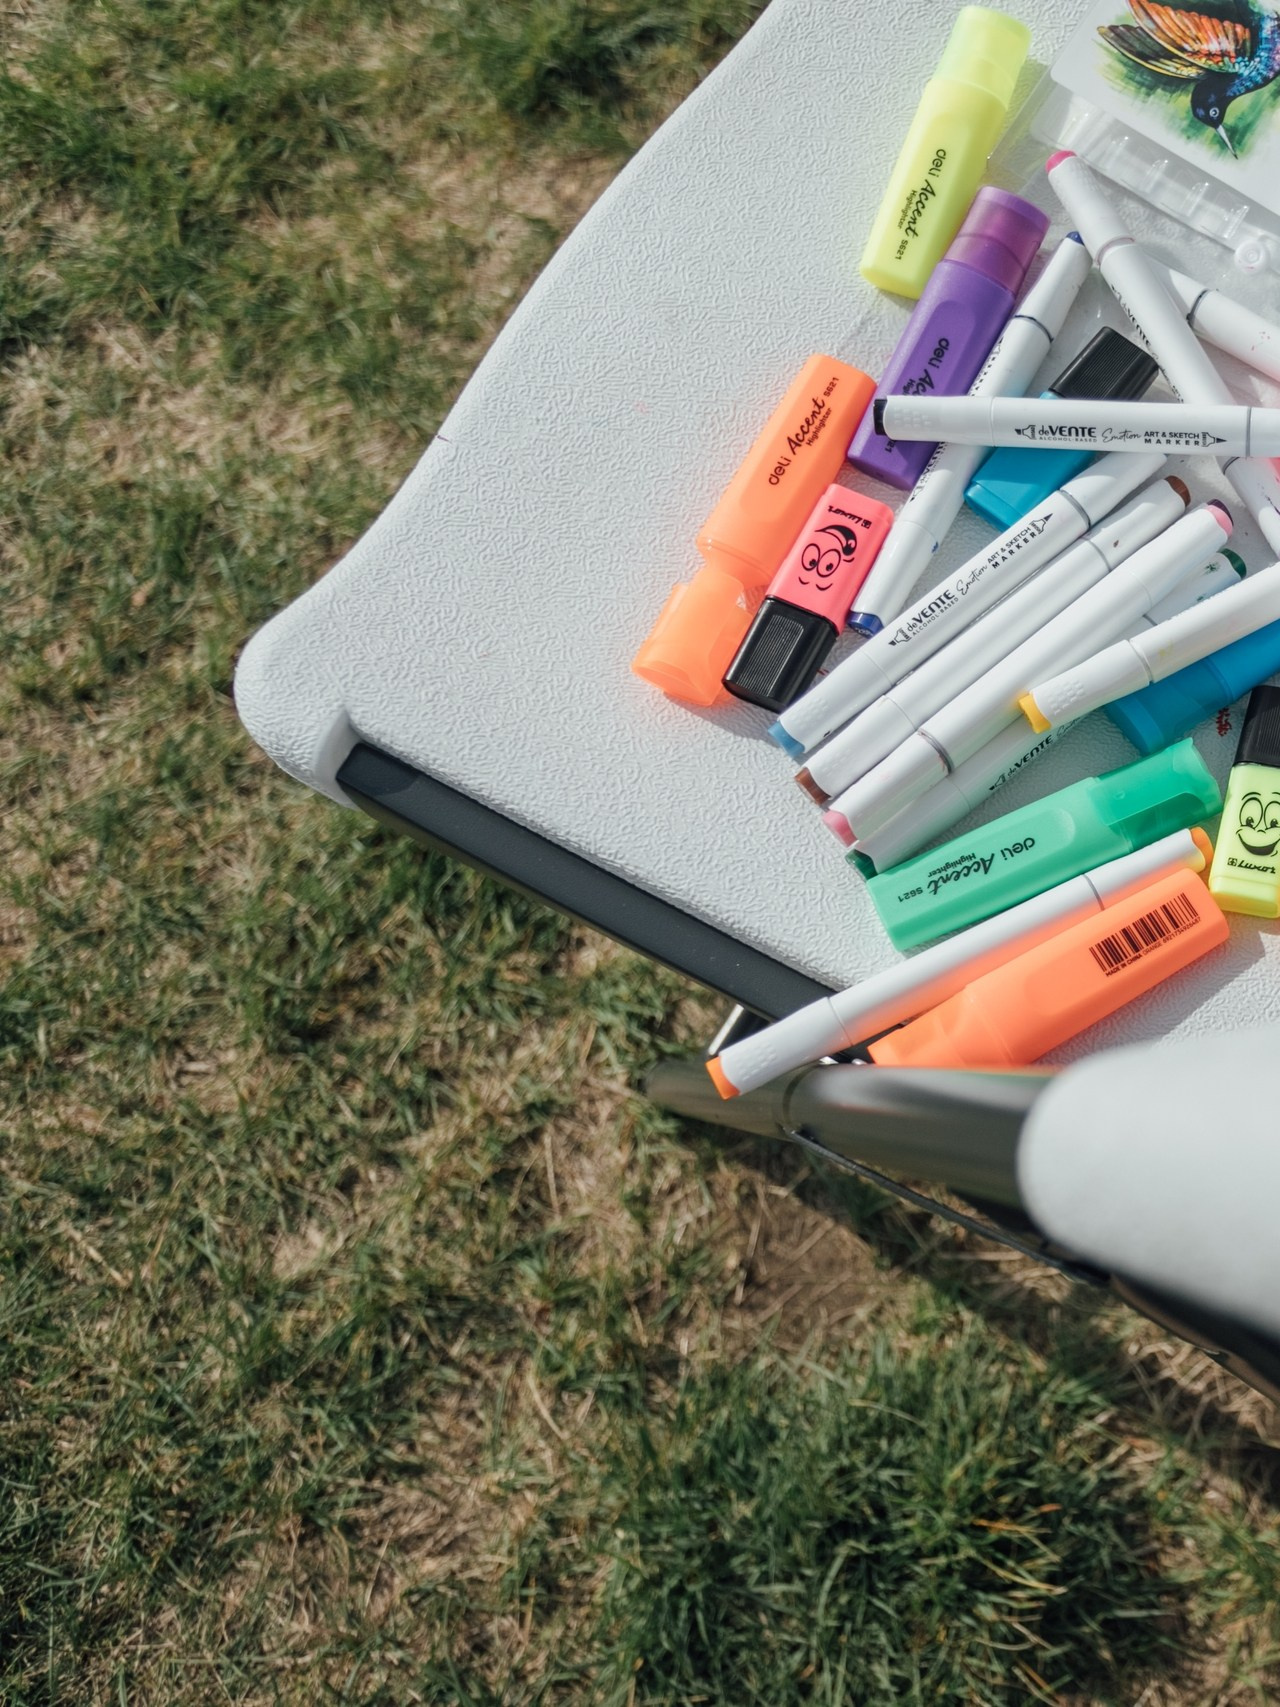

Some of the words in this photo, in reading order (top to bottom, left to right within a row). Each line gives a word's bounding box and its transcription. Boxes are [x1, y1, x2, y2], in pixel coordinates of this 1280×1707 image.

[928, 149, 947, 178] deli
[897, 189, 917, 230] Highlighter
[905, 178, 936, 240] Accent
[928, 337, 950, 369] deli
[768, 456, 792, 486] deli
[786, 396, 826, 455] Accent
[806, 407, 832, 446] Highlighter
[1038, 425, 1097, 438] deVENTE
[1101, 427, 1141, 443] Emotion
[1161, 431, 1167, 439] &
[1169, 431, 1200, 439] SKETCH
[1144, 438, 1200, 446] MARKER
[827, 505, 863, 525] Luxor
[991, 532, 1037, 569] MARKER
[906, 589, 955, 632] deVENTE
[956, 564, 988, 596] Emotion
[987, 551, 1000, 564] ART
[1005, 526, 1031, 549] SKETCH
[927, 853, 977, 879] Highlighter
[1001, 837, 1036, 862] deli
[928, 853, 996, 896] Accent
[1237, 859, 1277, 875] Luxor
[1105, 967, 1121, 978] MADE
[1127, 954, 1142, 965] CHINA
[1142, 943, 1163, 956] ORANGE
